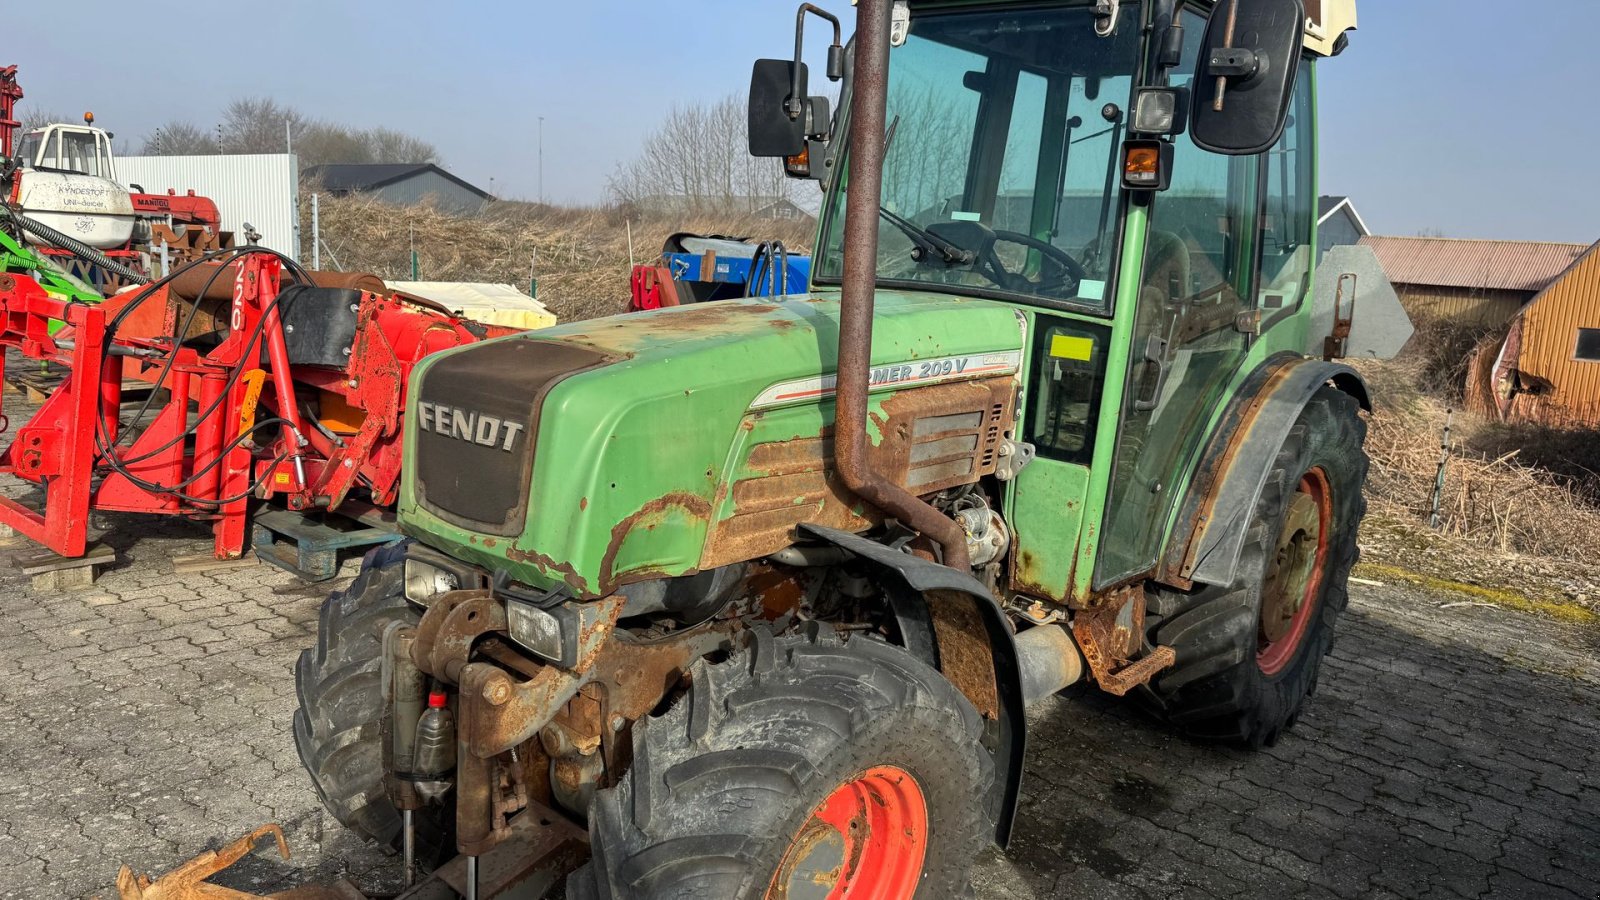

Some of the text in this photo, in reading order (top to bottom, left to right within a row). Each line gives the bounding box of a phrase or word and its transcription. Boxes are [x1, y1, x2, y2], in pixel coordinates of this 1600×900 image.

[232, 260, 245, 331] 220
[869, 364, 912, 384] MER
[919, 360, 952, 378] 209
[955, 358, 968, 373] V
[418, 401, 524, 453] FENDT
